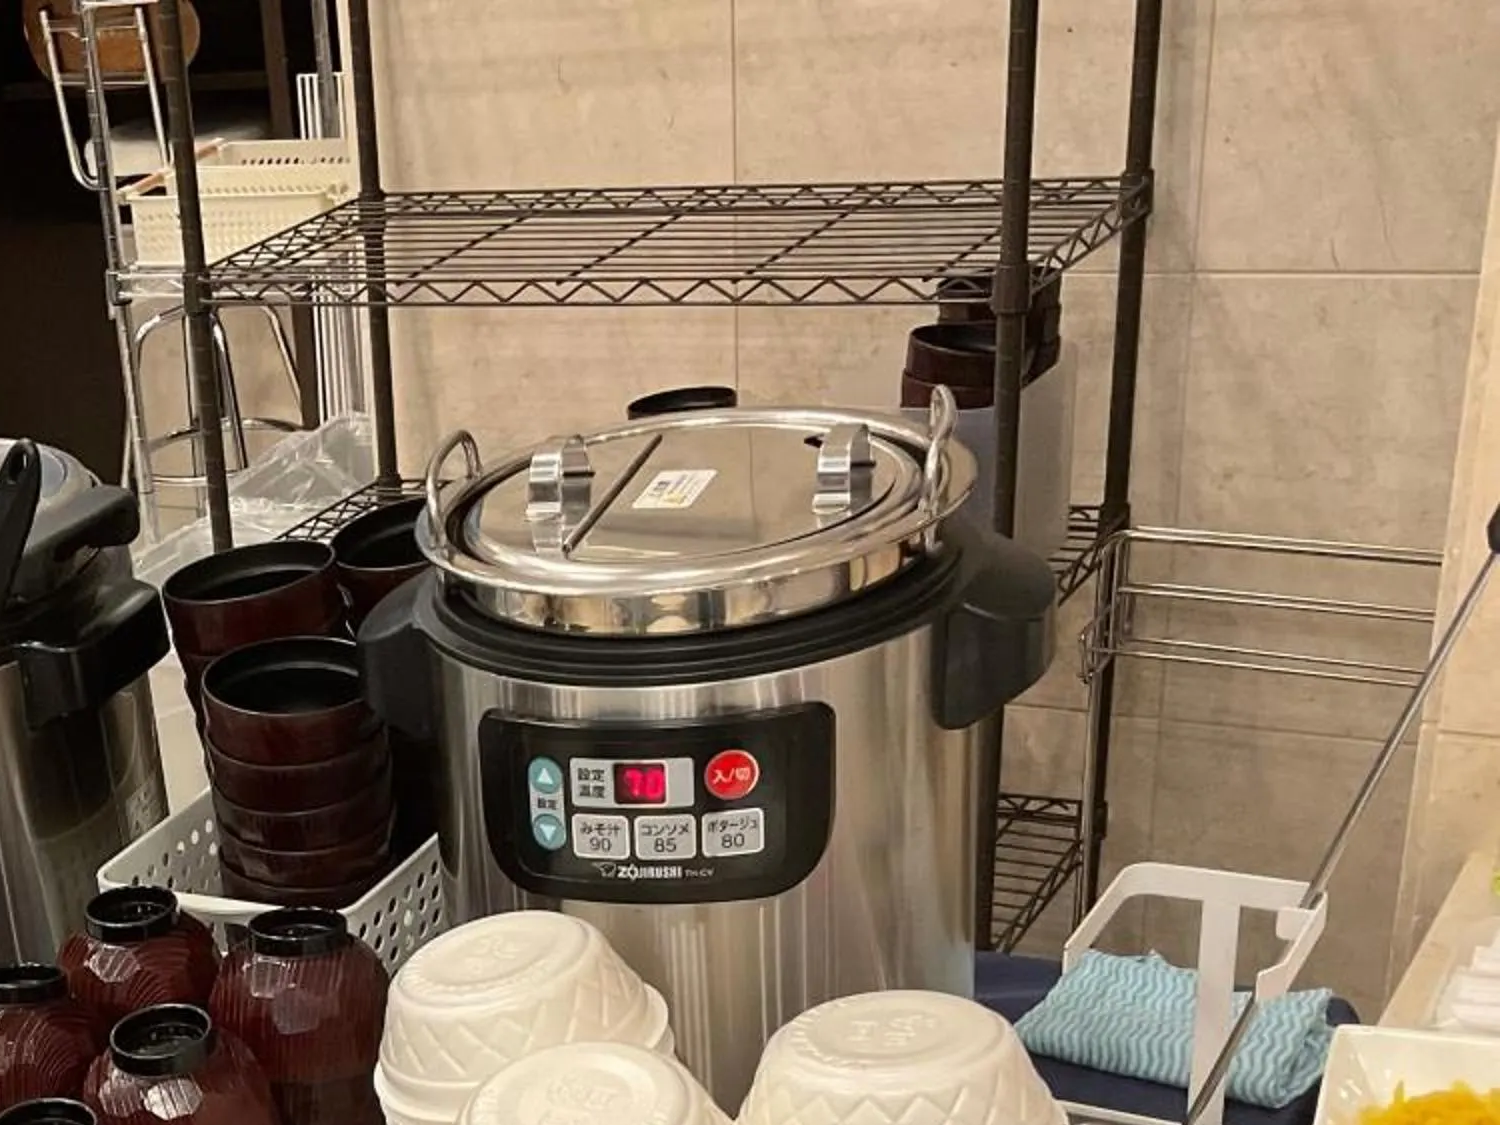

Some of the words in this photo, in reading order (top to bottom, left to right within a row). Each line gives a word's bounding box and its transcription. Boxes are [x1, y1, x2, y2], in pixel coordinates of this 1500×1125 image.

[580, 822, 621, 837] みそ汁
[641, 823, 690, 837] コンソメ
[707, 816, 758, 834] ポタージュ
[589, 837, 613, 852] 90
[653, 838, 678, 853] 85
[721, 833, 746, 849] 80
